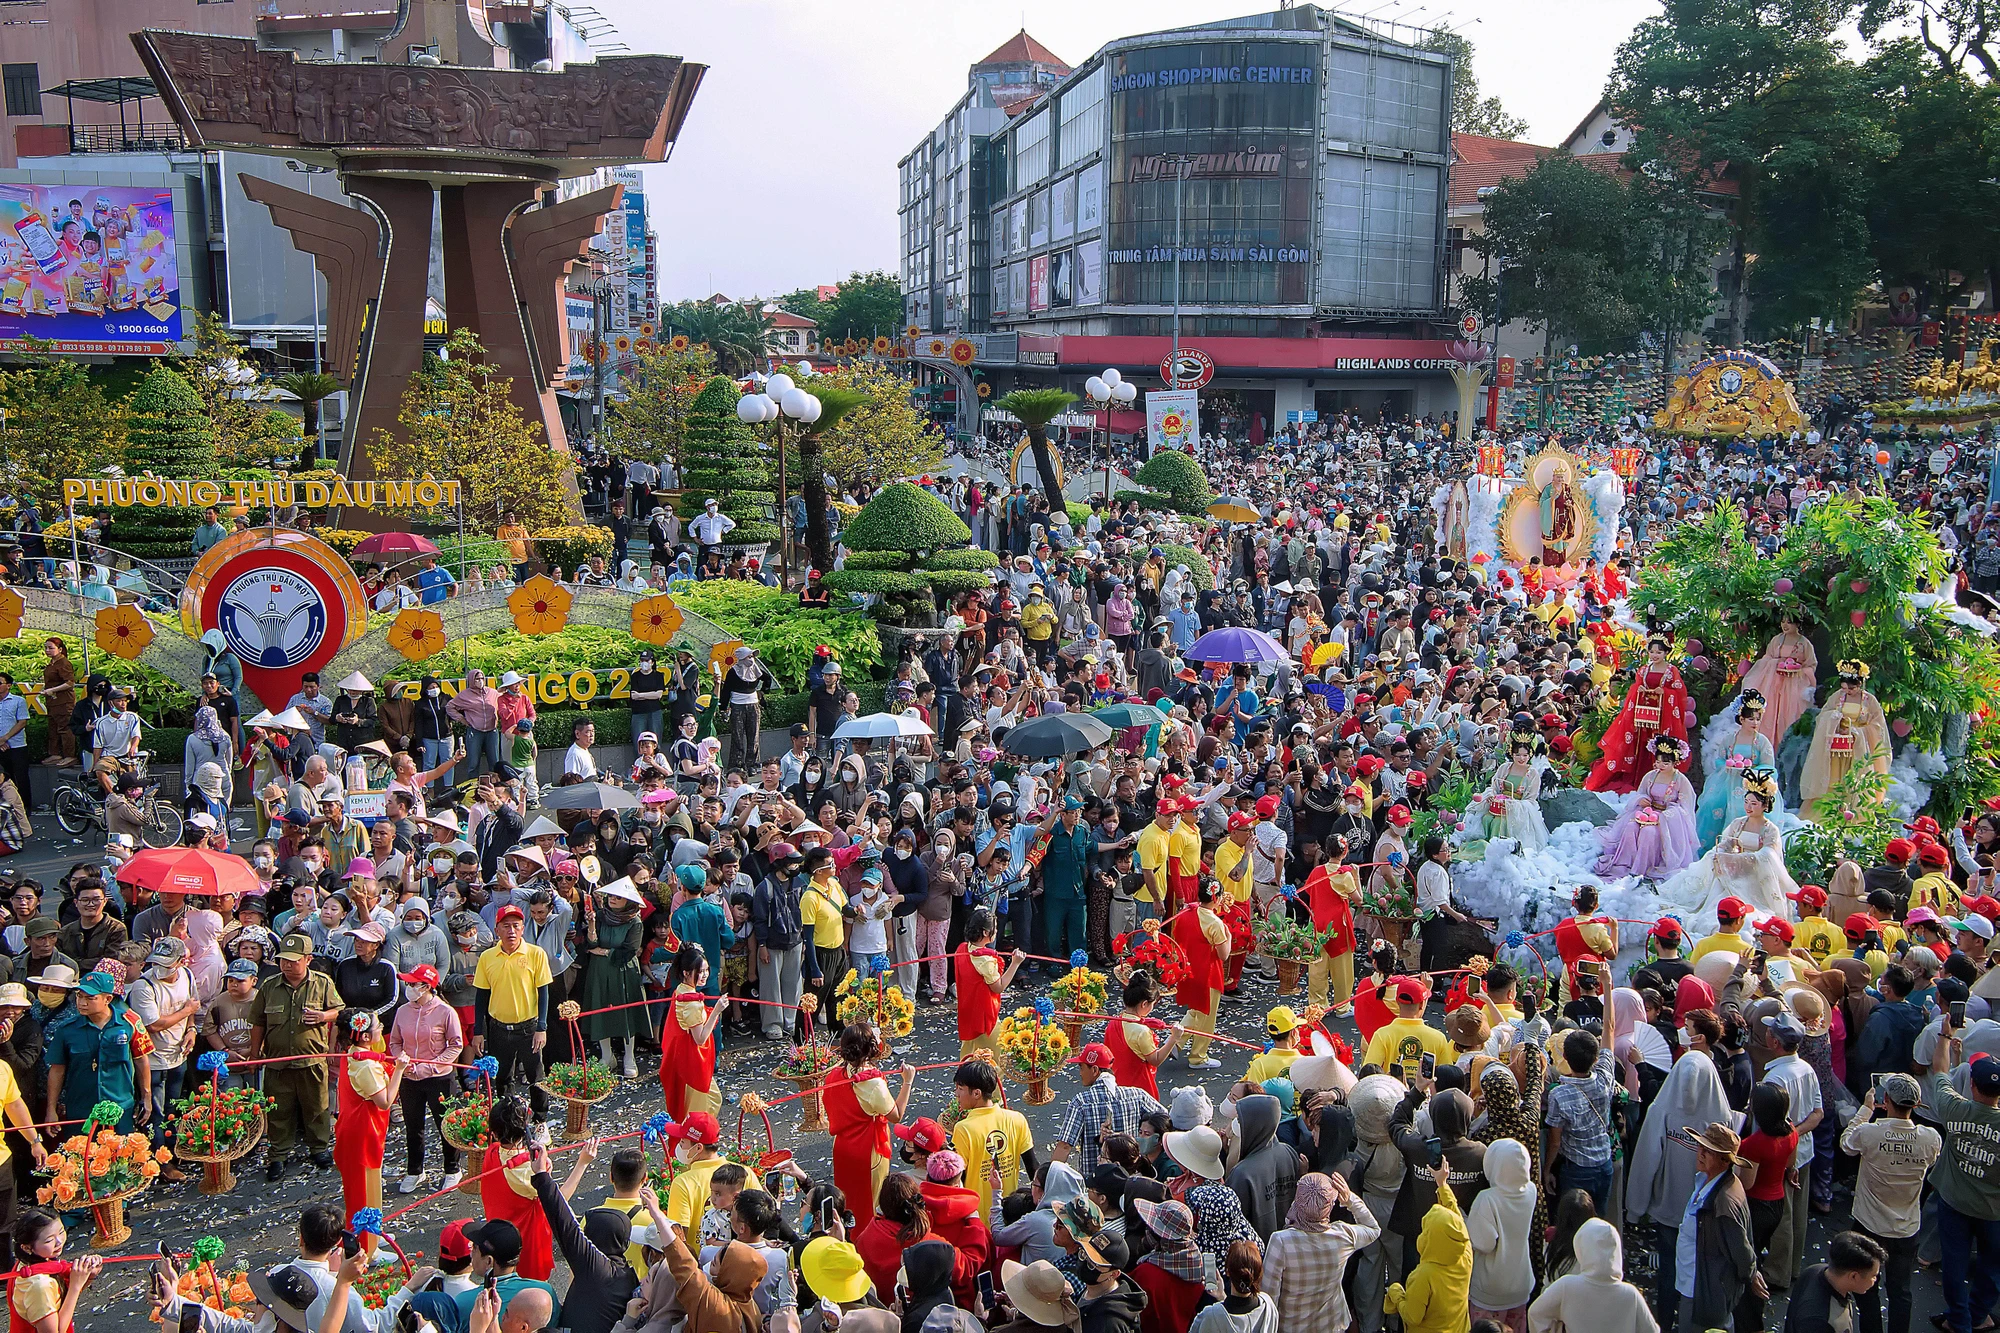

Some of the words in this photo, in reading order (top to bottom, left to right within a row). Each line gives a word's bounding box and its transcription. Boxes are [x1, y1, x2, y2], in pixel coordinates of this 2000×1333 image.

[1111, 71, 1155, 92] SAIGON
[1158, 66, 1241, 86] SHOPPING
[1246, 66, 1312, 84] CENTER
[1108, 249, 1142, 264] TRUNG
[1145, 244, 1172, 263] TÂM
[1177, 247, 1207, 263] MUA
[1210, 240, 1244, 263] SẮM
[1249, 243, 1273, 263] SÀI
[1277, 243, 1309, 263] GÒN
[119, 325, 142, 333] 1900
[144, 326, 169, 334] 6608
[1163, 350, 1211, 368] HIHLANDS
[1336, 358, 1411, 370] HIGHLANDS
[64, 471, 220, 508] PHƯỜNG
[229, 470, 294, 508] THỦ
[306, 470, 376, 508] DẦU
[383, 473, 461, 514] MỘT
[231, 574, 260, 597] PHƯỜNG
[261, 572, 277, 582] THỦ
[294, 583, 311, 597] MỘT
[327, 946, 342, 958] 30
[1405, 1043, 1417, 1055] 89
[1885, 1130, 1917, 1141] CALVIN
[1879, 1142, 1913, 1154] KLEIN
[1956, 1138, 1996, 1167] lifting
[1413, 1164, 1430, 1177] THE
[1959, 1160, 1985, 1179] club
